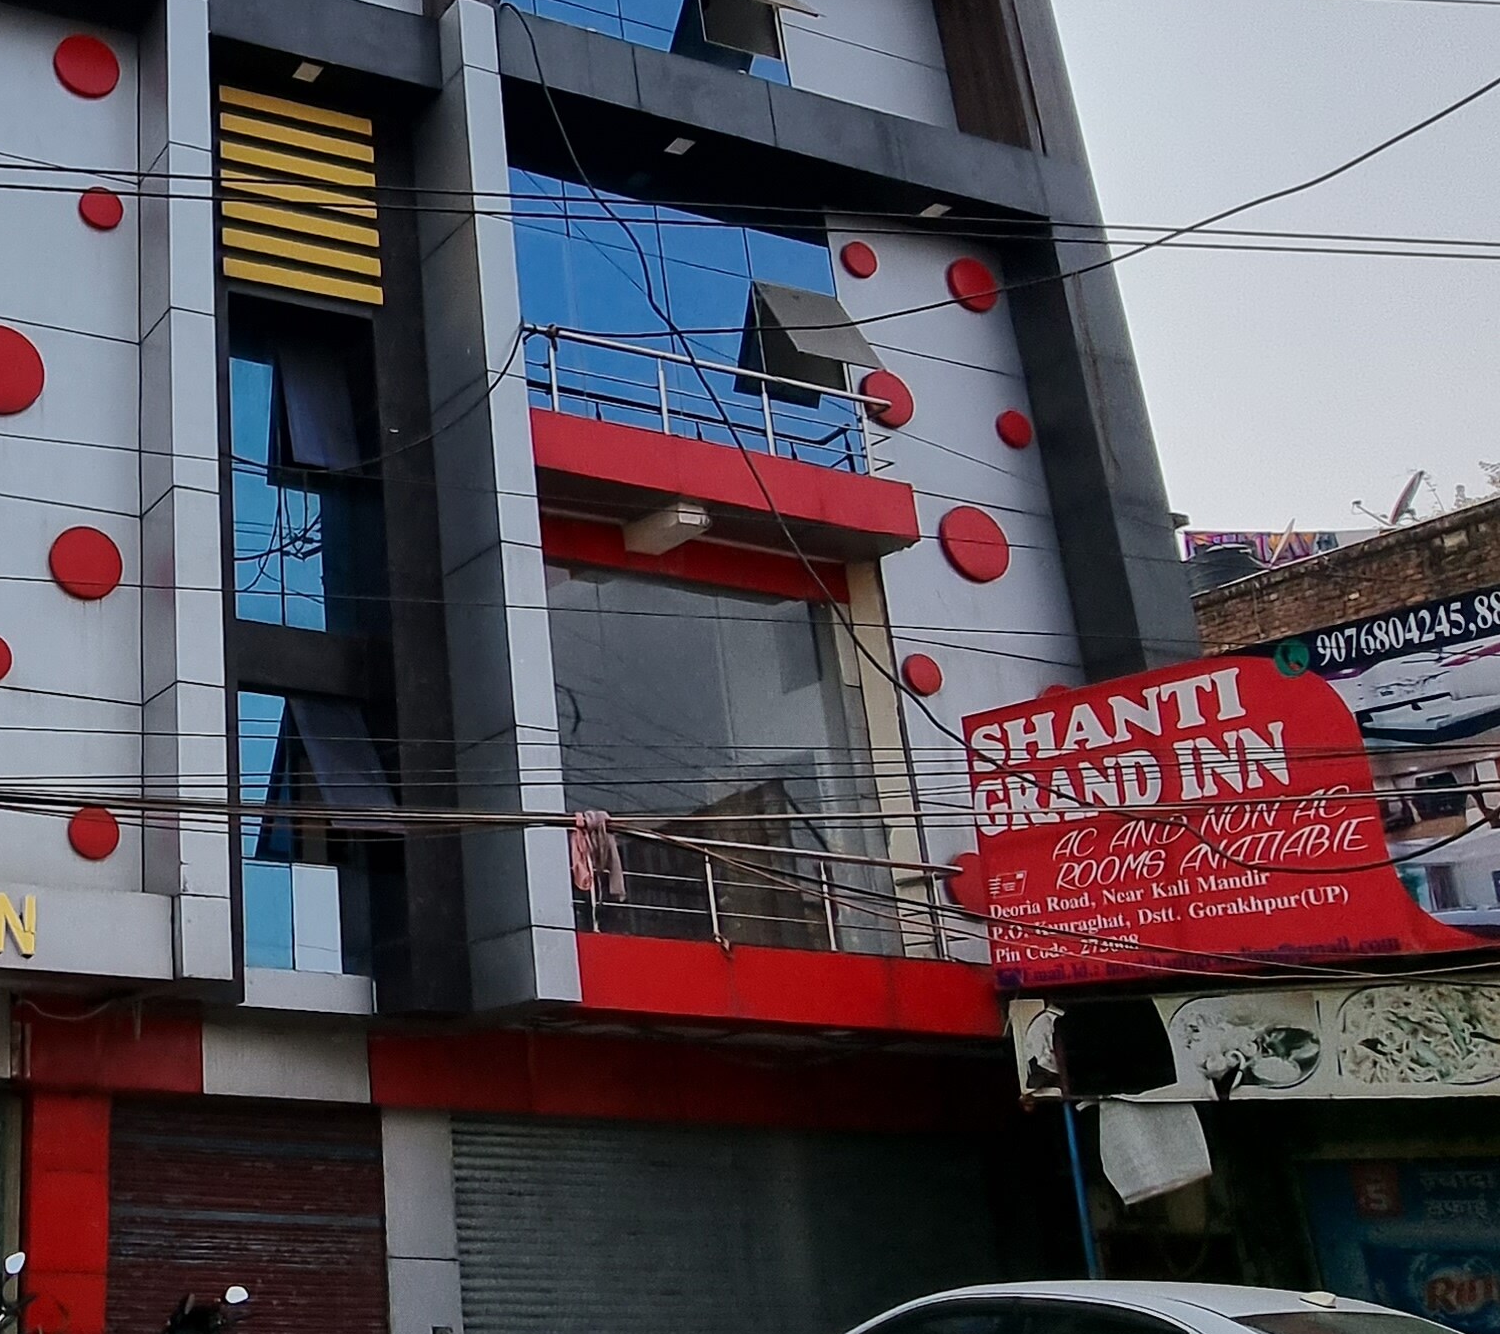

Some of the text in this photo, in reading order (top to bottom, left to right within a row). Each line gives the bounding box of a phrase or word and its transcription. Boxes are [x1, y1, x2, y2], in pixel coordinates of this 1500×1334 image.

[970, 667, 1247, 773] SHANTI
[974, 721, 1290, 836] GRAND INN
[1052, 785, 1351, 861] AC AND NON AC
[989, 869, 1271, 918] Deoria Road, Near Kali Mandir
[1056, 849, 1167, 890] ROOMS
[1137, 906, 1182, 926] Dstt.
[1188, 884, 1350, 920] Gorakhpur(UP)
[995, 948, 1021, 964] Pin
